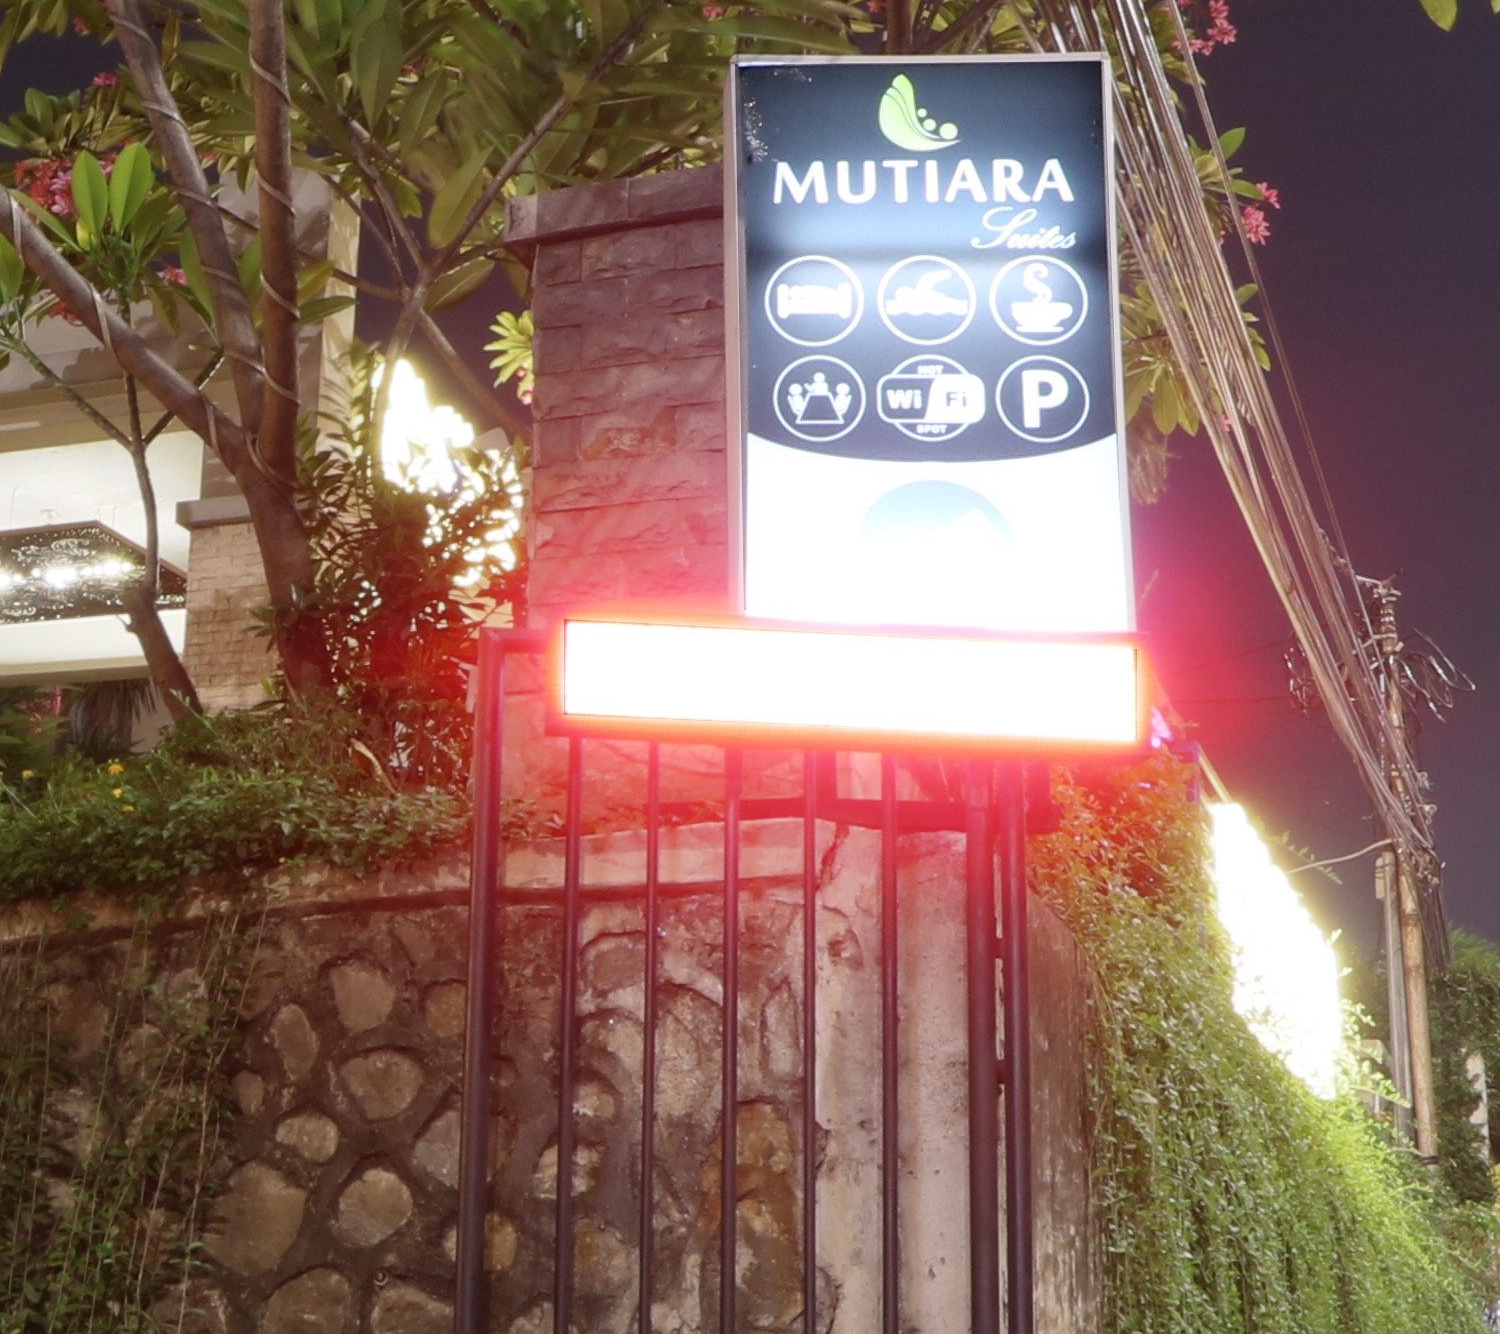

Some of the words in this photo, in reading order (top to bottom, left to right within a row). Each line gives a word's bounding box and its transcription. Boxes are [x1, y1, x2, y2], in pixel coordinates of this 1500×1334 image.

[773, 158, 1075, 204] MUTIARA
[971, 207, 1077, 249] Suites
[917, 365, 944, 375] HOT
[886, 389, 923, 409] Wi
[945, 391, 968, 408] Fi
[1021, 369, 1069, 429] P
[916, 424, 948, 434] SPOT
